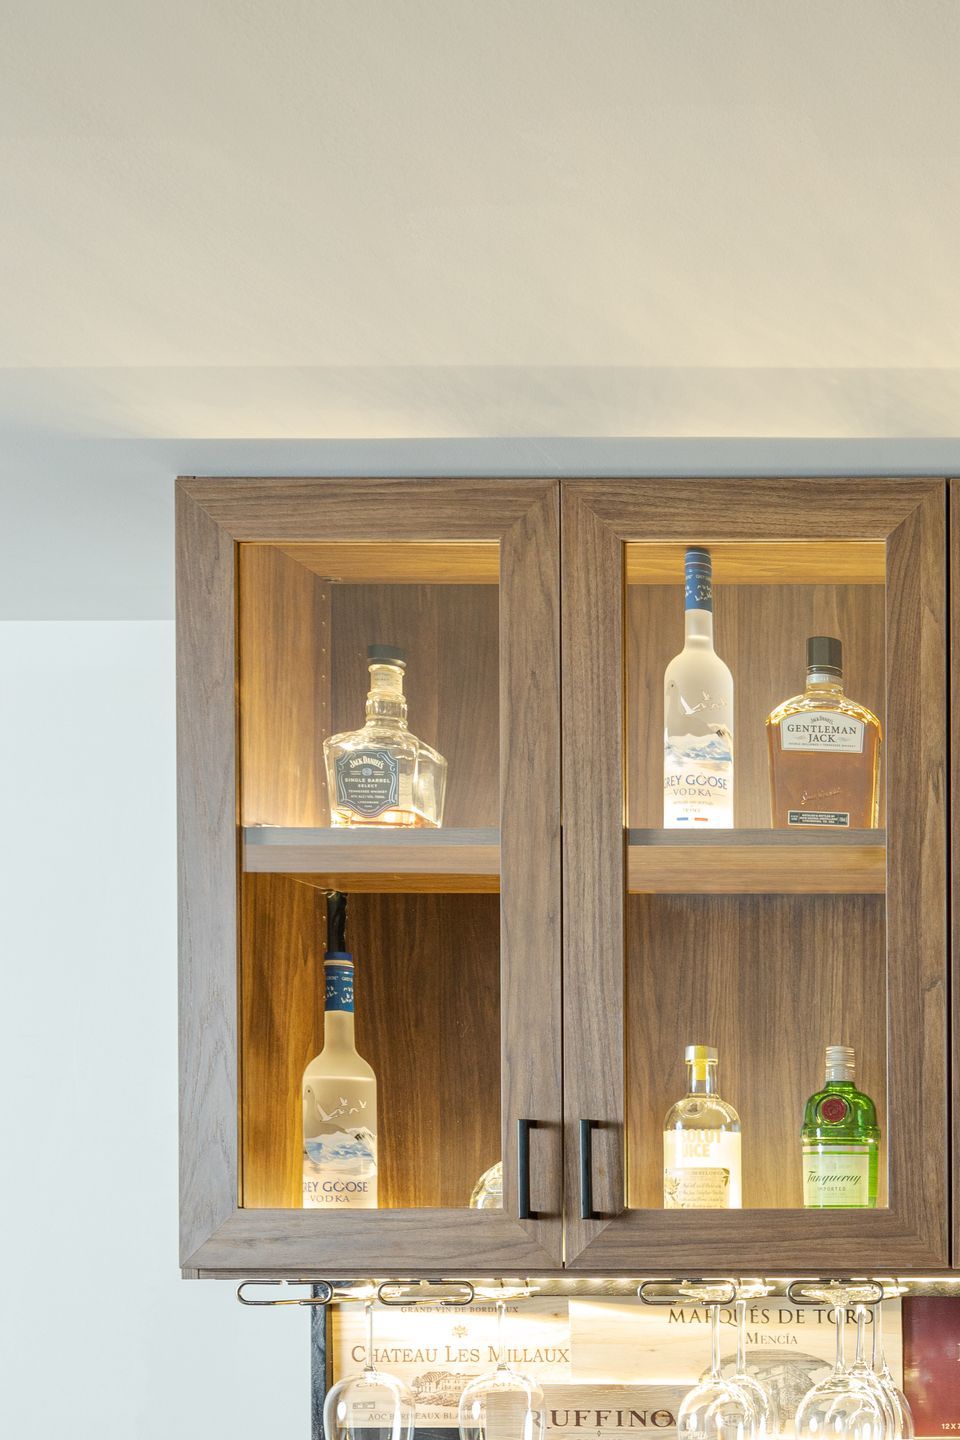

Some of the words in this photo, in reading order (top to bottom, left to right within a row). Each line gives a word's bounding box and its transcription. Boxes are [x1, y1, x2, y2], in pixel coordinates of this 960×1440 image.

[787, 724, 857, 735] GENTLEMAN
[809, 734, 836, 743] JACK
[685, 774, 728, 790] GOOSE
[673, 788, 712, 797] VODKA
[807, 1170, 862, 1186] Tanqueray
[322, 1181, 369, 1193] GOOSE
[310, 1194, 350, 1203] VODKA
[779, 1309, 806, 1324] DE
[444, 1345, 480, 1363] LES
